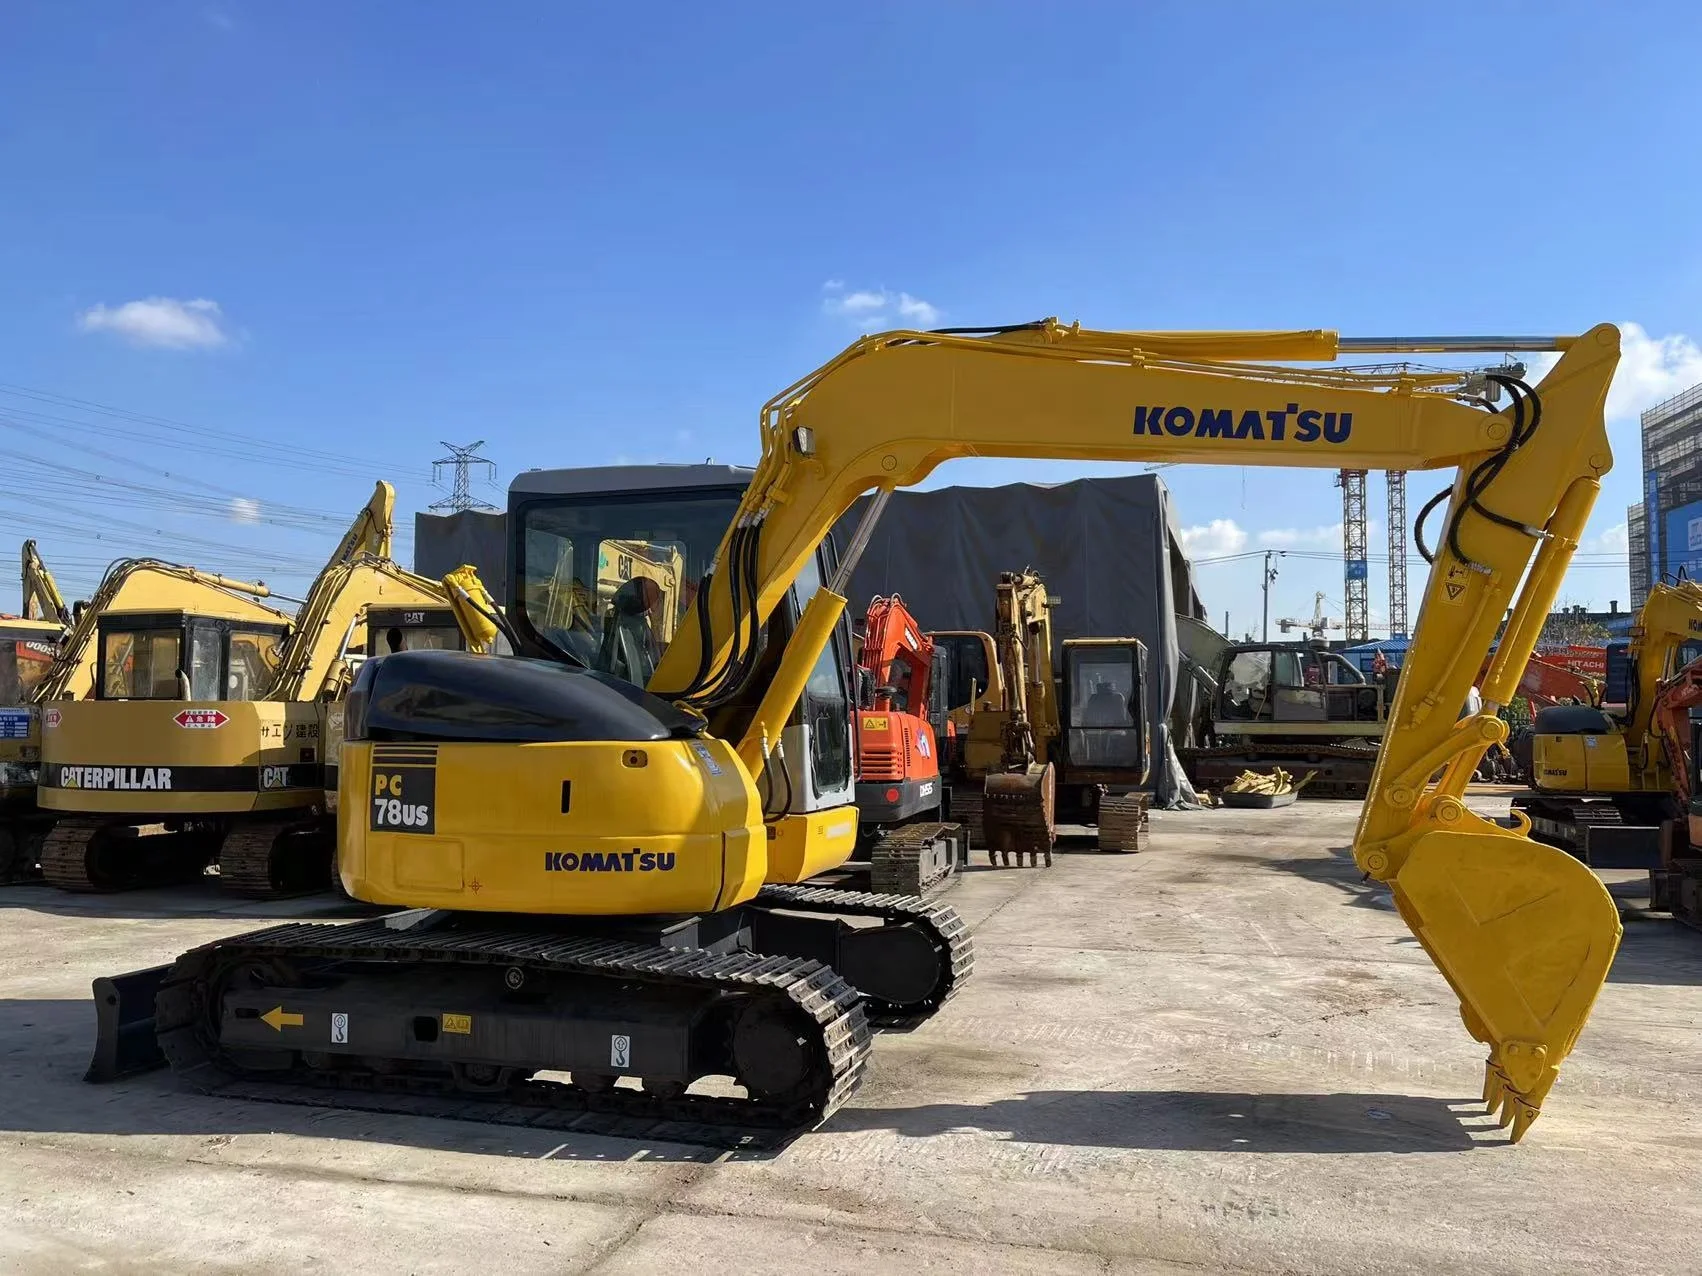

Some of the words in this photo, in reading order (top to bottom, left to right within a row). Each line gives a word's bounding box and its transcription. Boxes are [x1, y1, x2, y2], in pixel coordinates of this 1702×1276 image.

[1133, 403, 1353, 444] KOMATSU
[618, 553, 633, 580] CAT
[404, 612, 425, 624] CAT
[61, 766, 172, 789] CATERPILLAR
[263, 767, 289, 788] CAT
[375, 774, 402, 796] PC
[374, 798, 429, 826] 78US
[545, 847, 675, 871] KOMATSU
